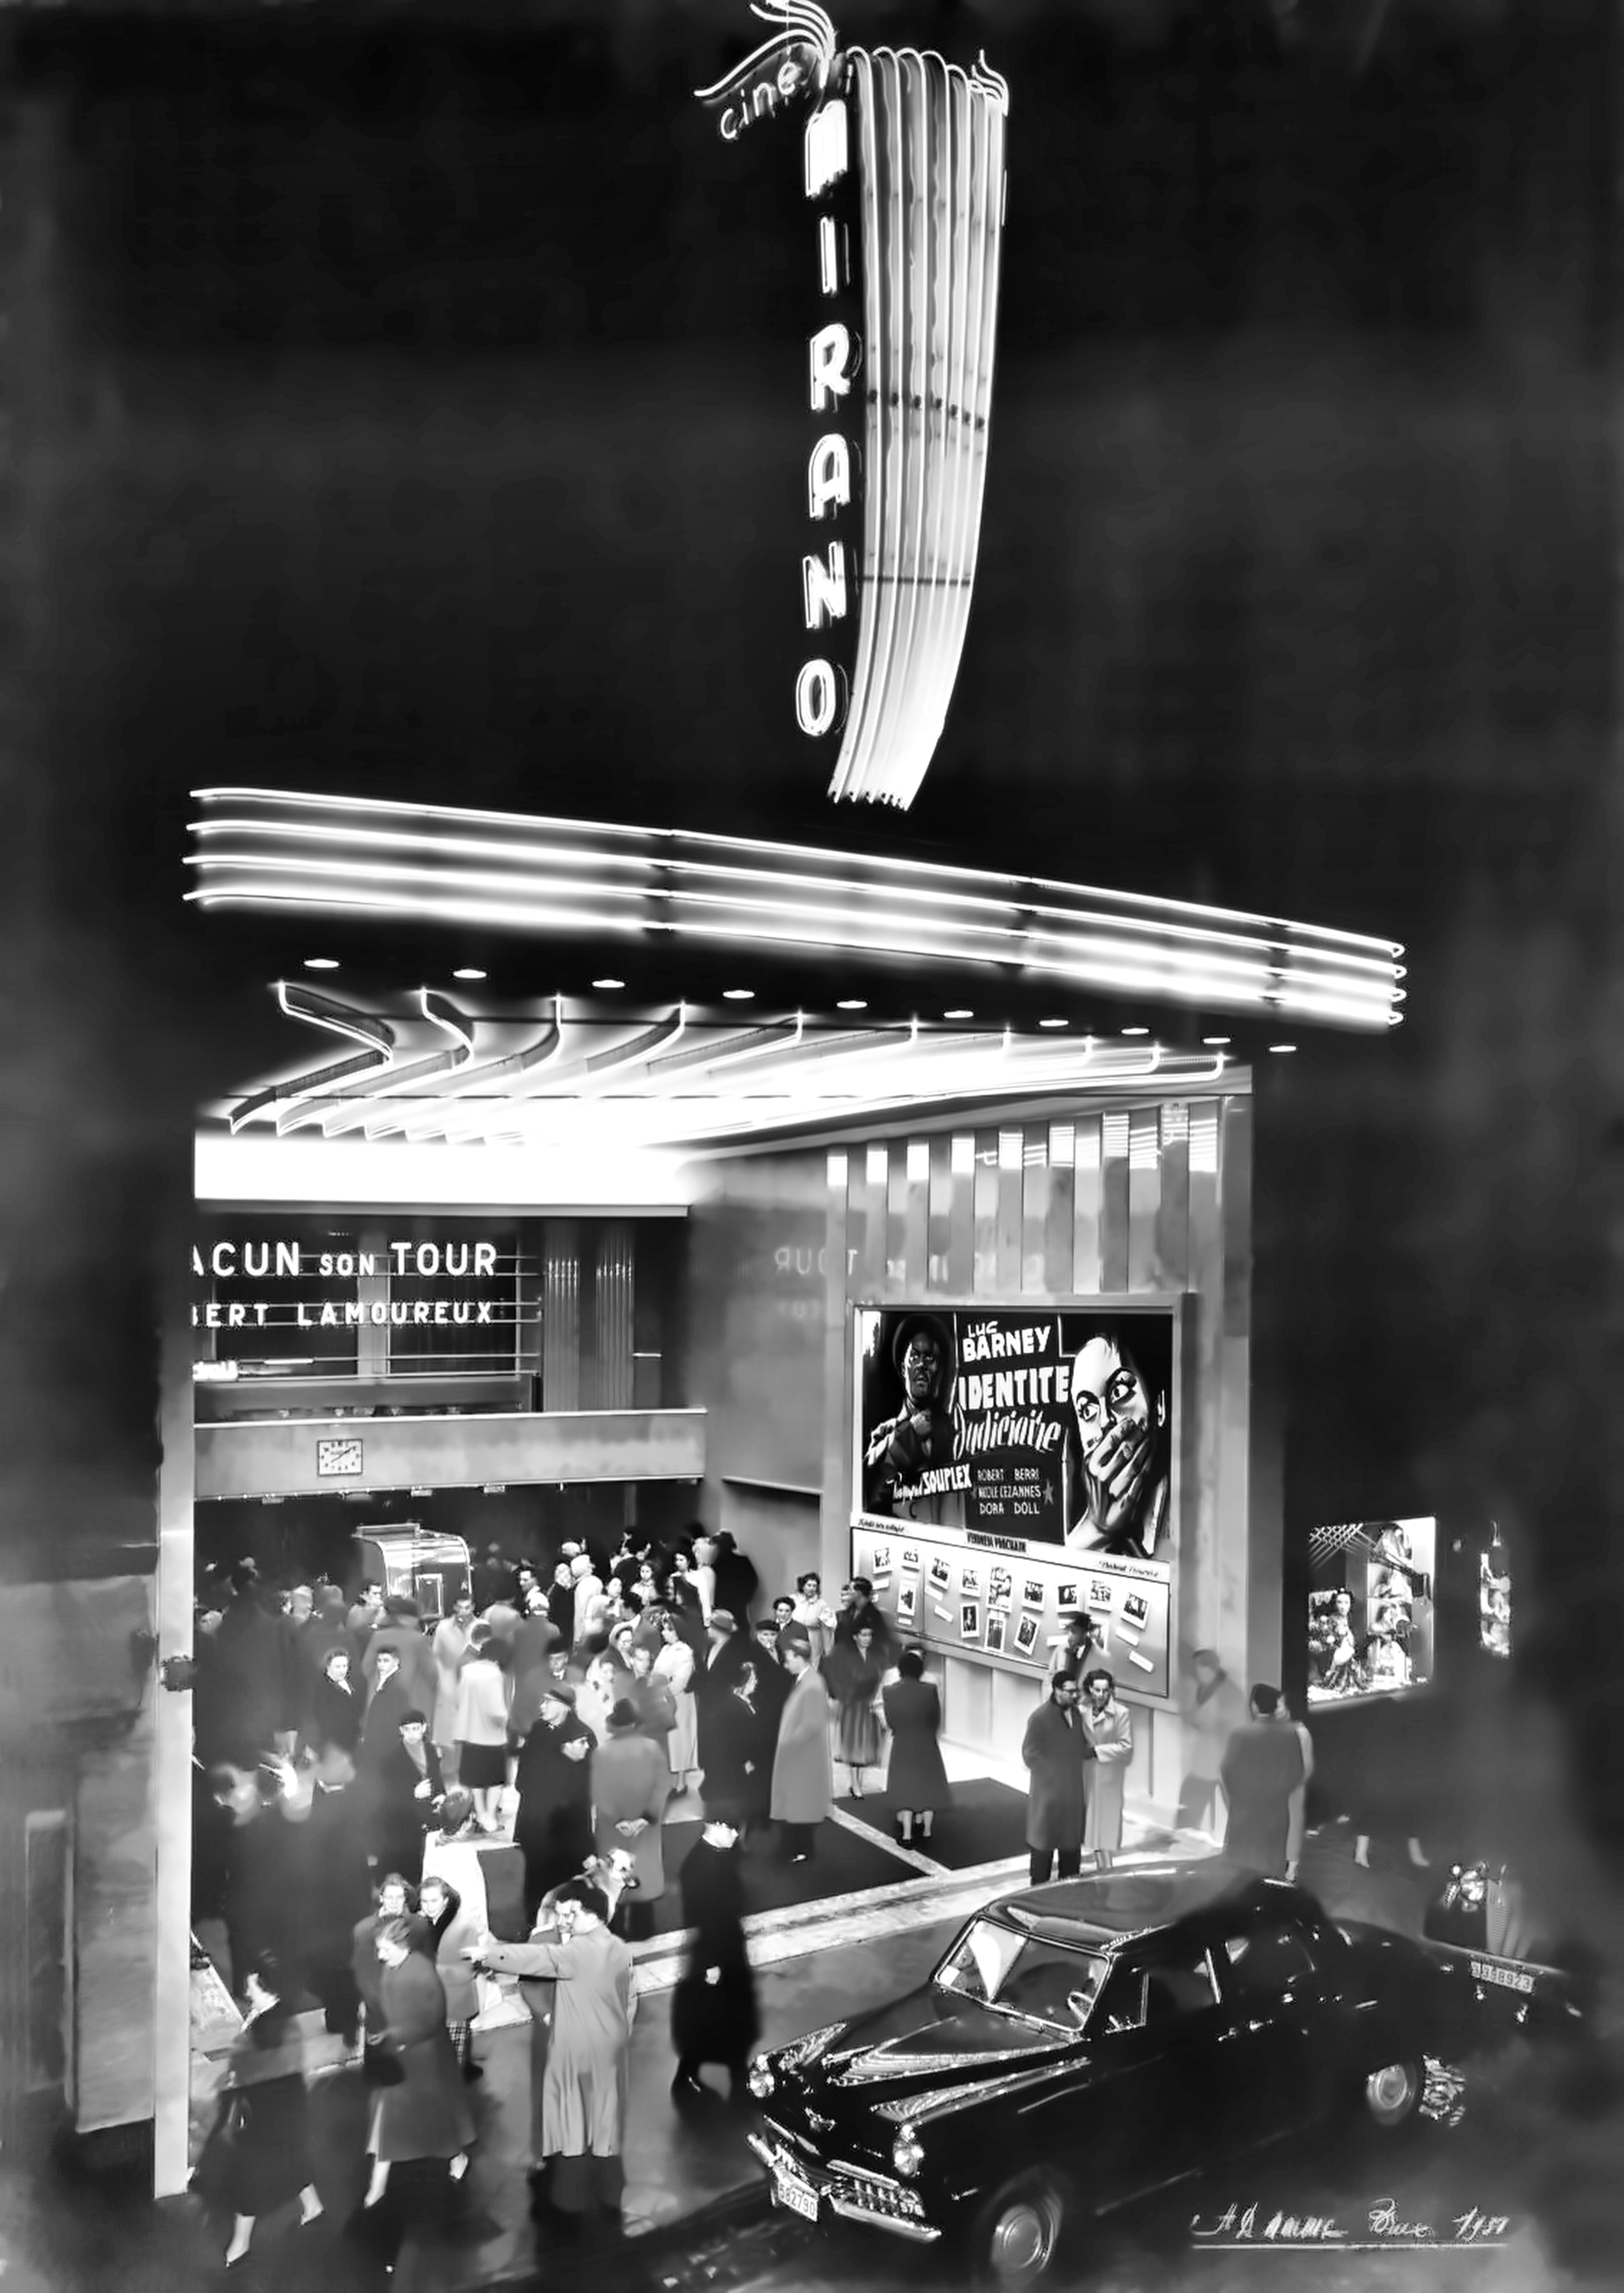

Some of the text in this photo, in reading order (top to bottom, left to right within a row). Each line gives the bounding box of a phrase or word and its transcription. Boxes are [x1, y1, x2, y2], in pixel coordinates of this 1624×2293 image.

[319, 1252, 376, 1276] SON
[391, 1241, 498, 1277] TOUR
[297, 1301, 492, 1327] LAMOUREUX
[962, 1325, 1050, 1363] BARNEY
[967, 1321, 998, 1338] LUC
[958, 1365, 1070, 1410] IDENTITE
[922, 1463, 972, 1495] SOUPLEX
[977, 1468, 1005, 1481] ROBERT
[980, 1501, 1041, 1515] DORA DOLL
